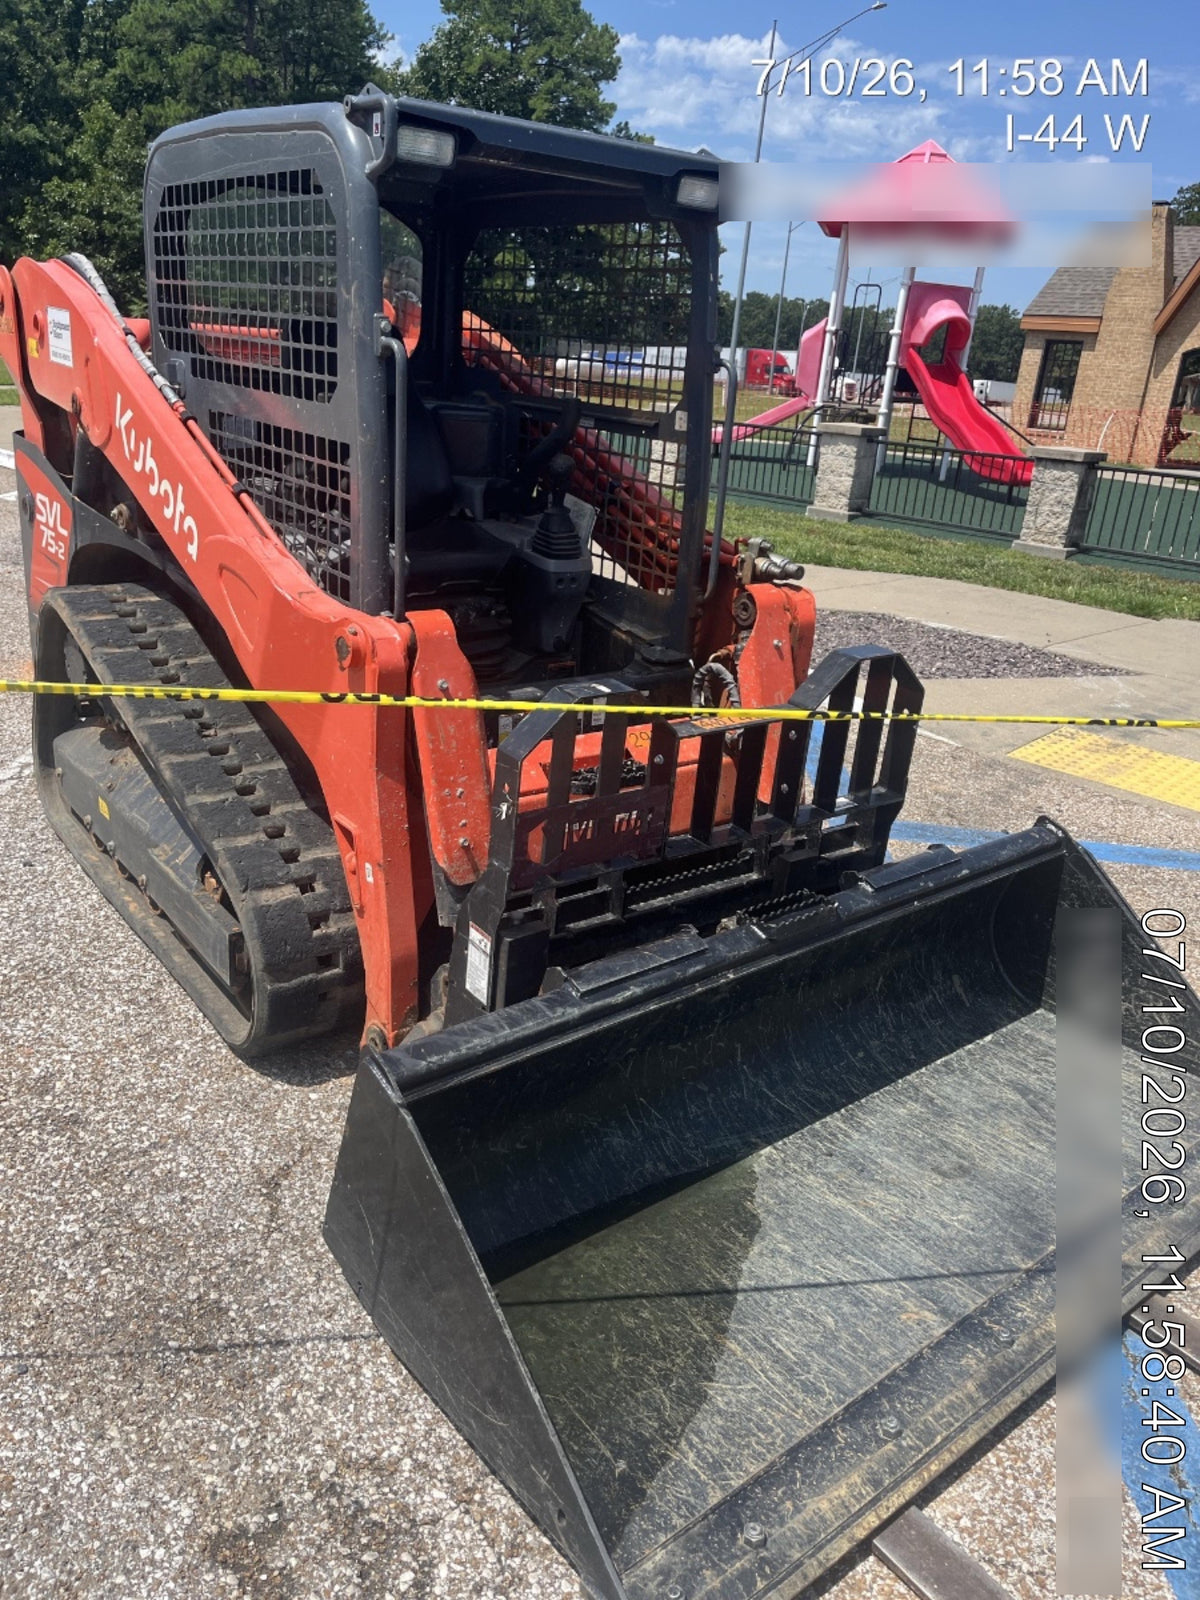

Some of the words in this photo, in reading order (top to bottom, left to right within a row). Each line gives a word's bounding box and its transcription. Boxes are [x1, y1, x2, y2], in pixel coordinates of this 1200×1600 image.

[115, 391, 198, 562] Kubota
[35, 492, 68, 537] SVL
[39, 524, 65, 560] 75-2
